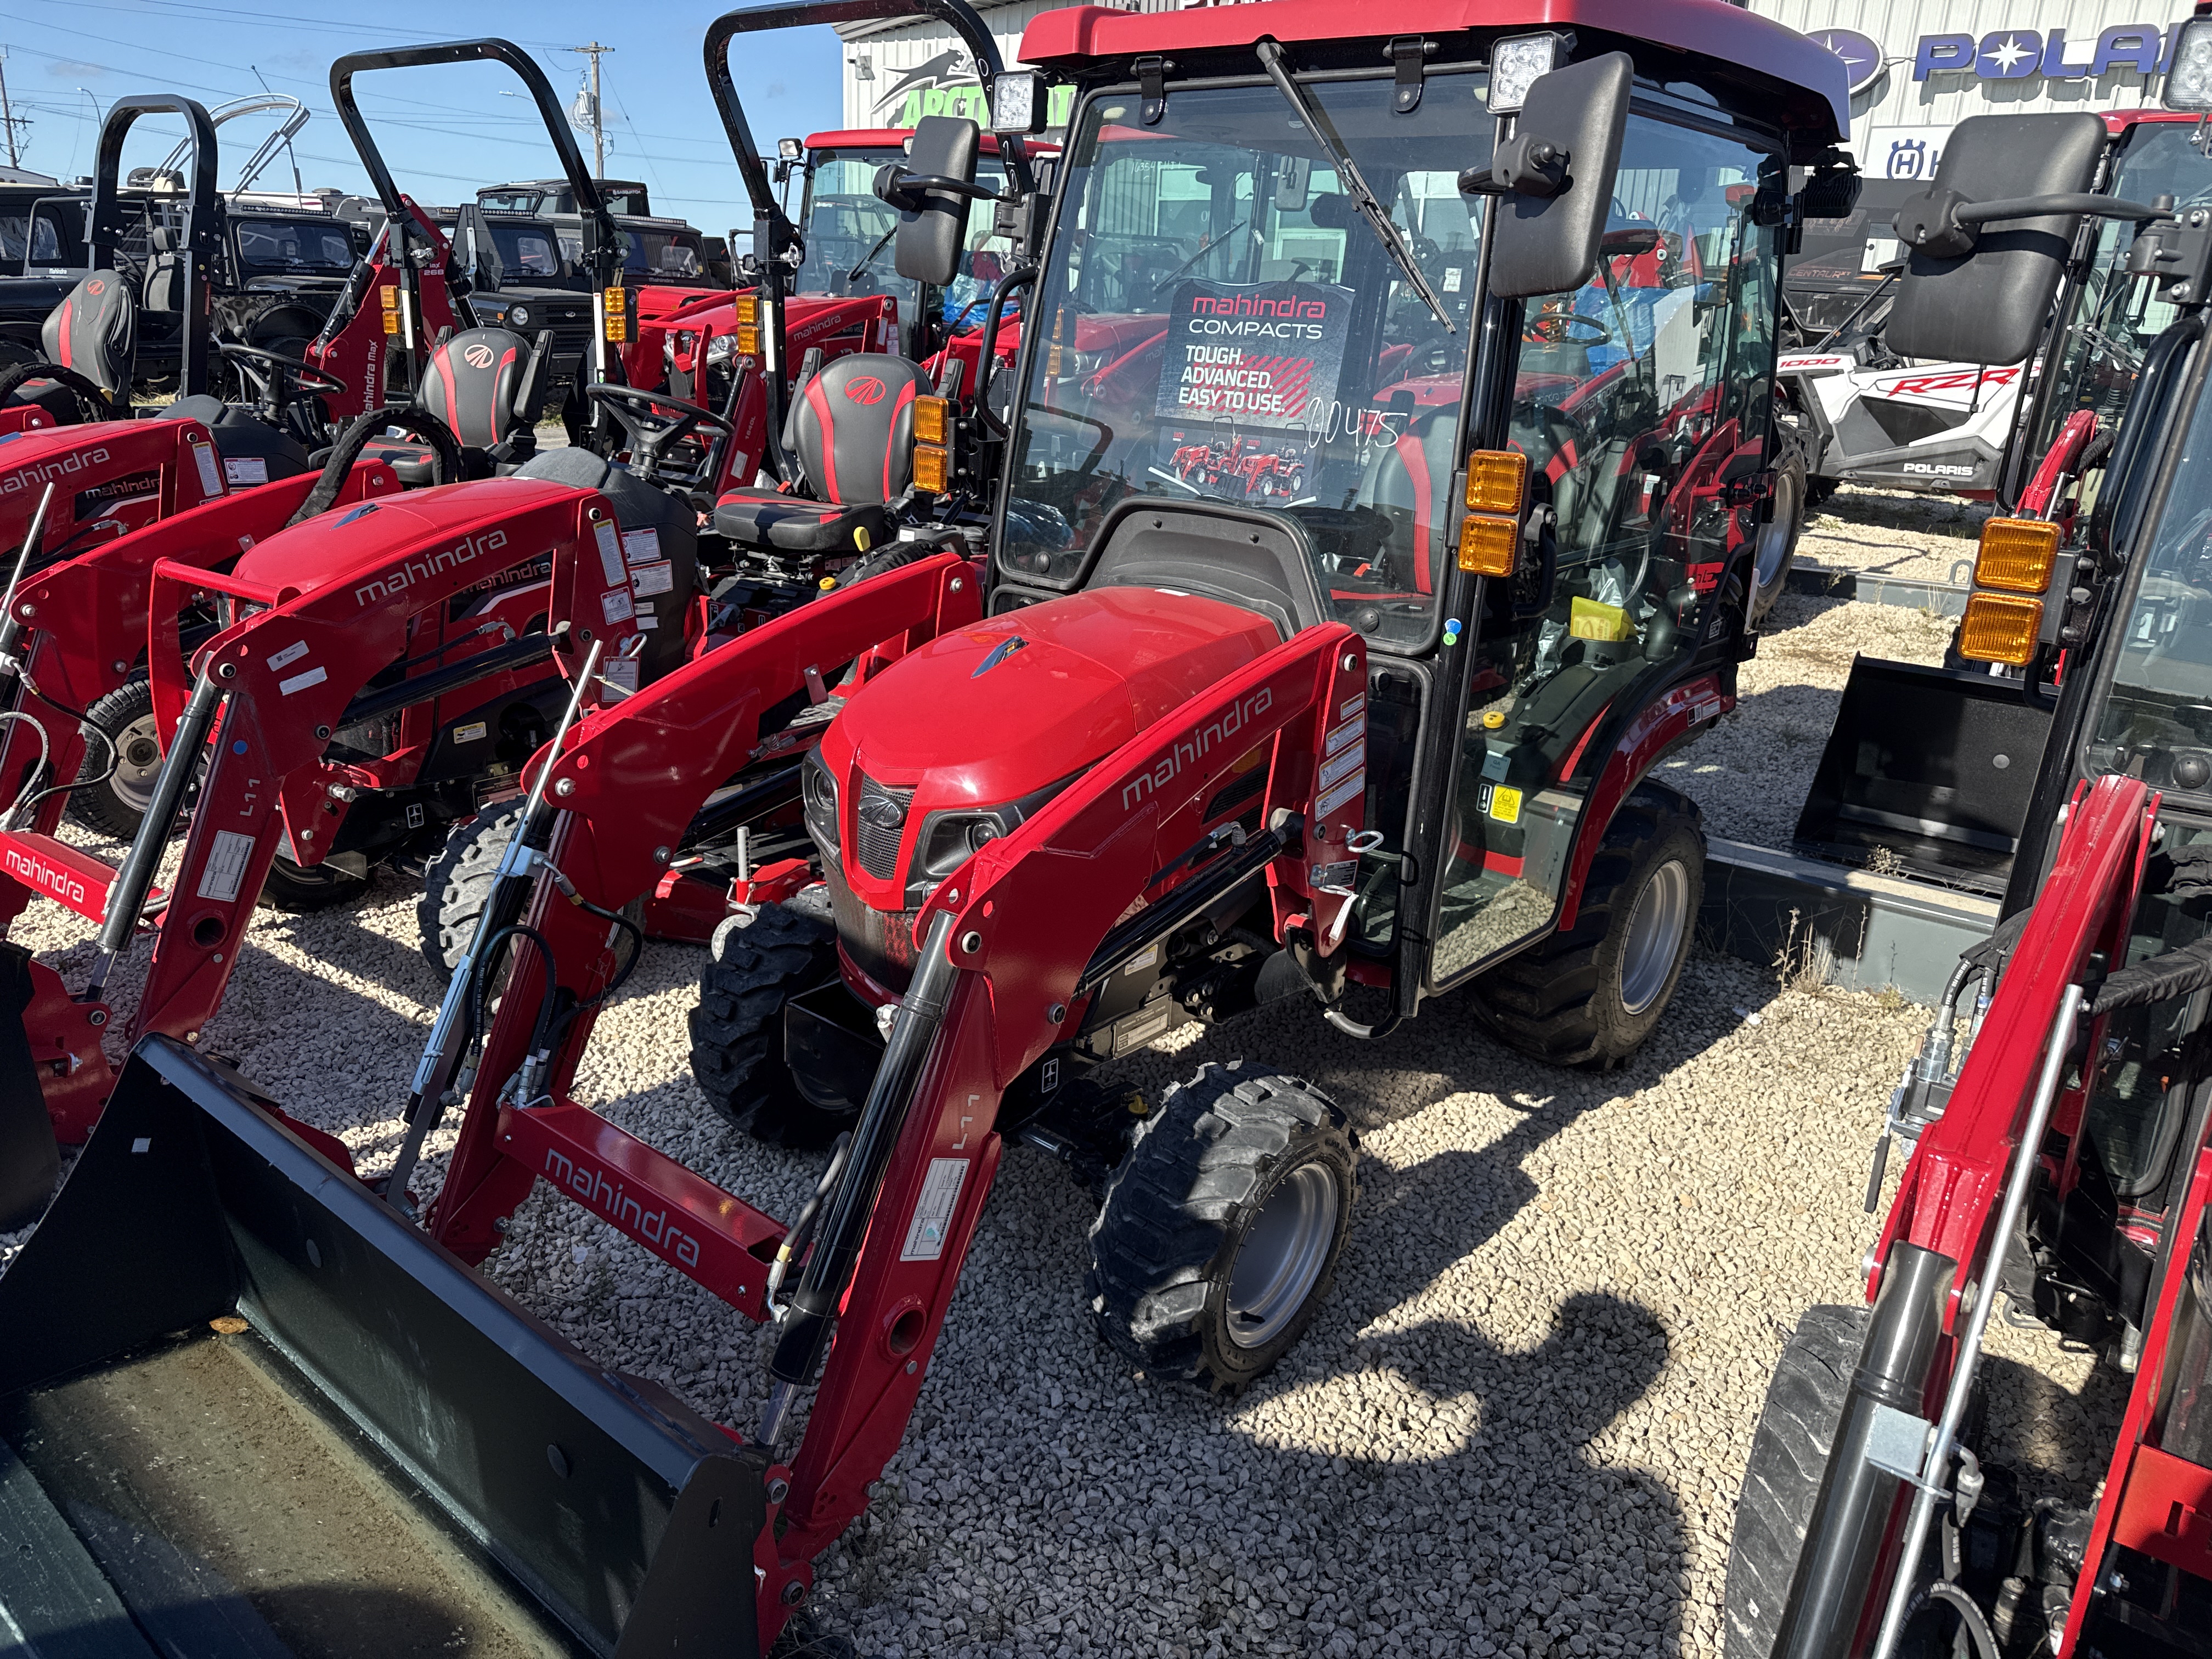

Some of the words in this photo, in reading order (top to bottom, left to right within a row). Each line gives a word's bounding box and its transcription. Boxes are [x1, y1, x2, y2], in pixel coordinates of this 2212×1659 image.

[901, 86, 989, 129] ARCTI
[1192, 294, 1326, 318] mahindra
[793, 315, 842, 342] mahindra
[1189, 319, 1323, 339] COMPACTS
[369, 339, 379, 362] max
[1186, 345, 1244, 365] TOUGH.
[1780, 358, 1841, 368] 1000
[1181, 366, 1273, 389] ADVANCED.
[1886, 368, 2021, 398] RZR
[1178, 387, 1223, 407] EASY
[1223, 391, 1244, 407] TO
[1248, 393, 1285, 412] USE.
[1307, 397, 1408, 449] 00475
[0, 448, 110, 494] ahindra
[1904, 463, 1973, 476] POLARIS
[355, 530, 507, 606] mahindra
[1122, 687, 1273, 810] mahindra
[5, 849, 85, 904] mahindra
[545, 1148, 700, 1268] mahindra
[911, 1218, 925, 1255] mahindra
